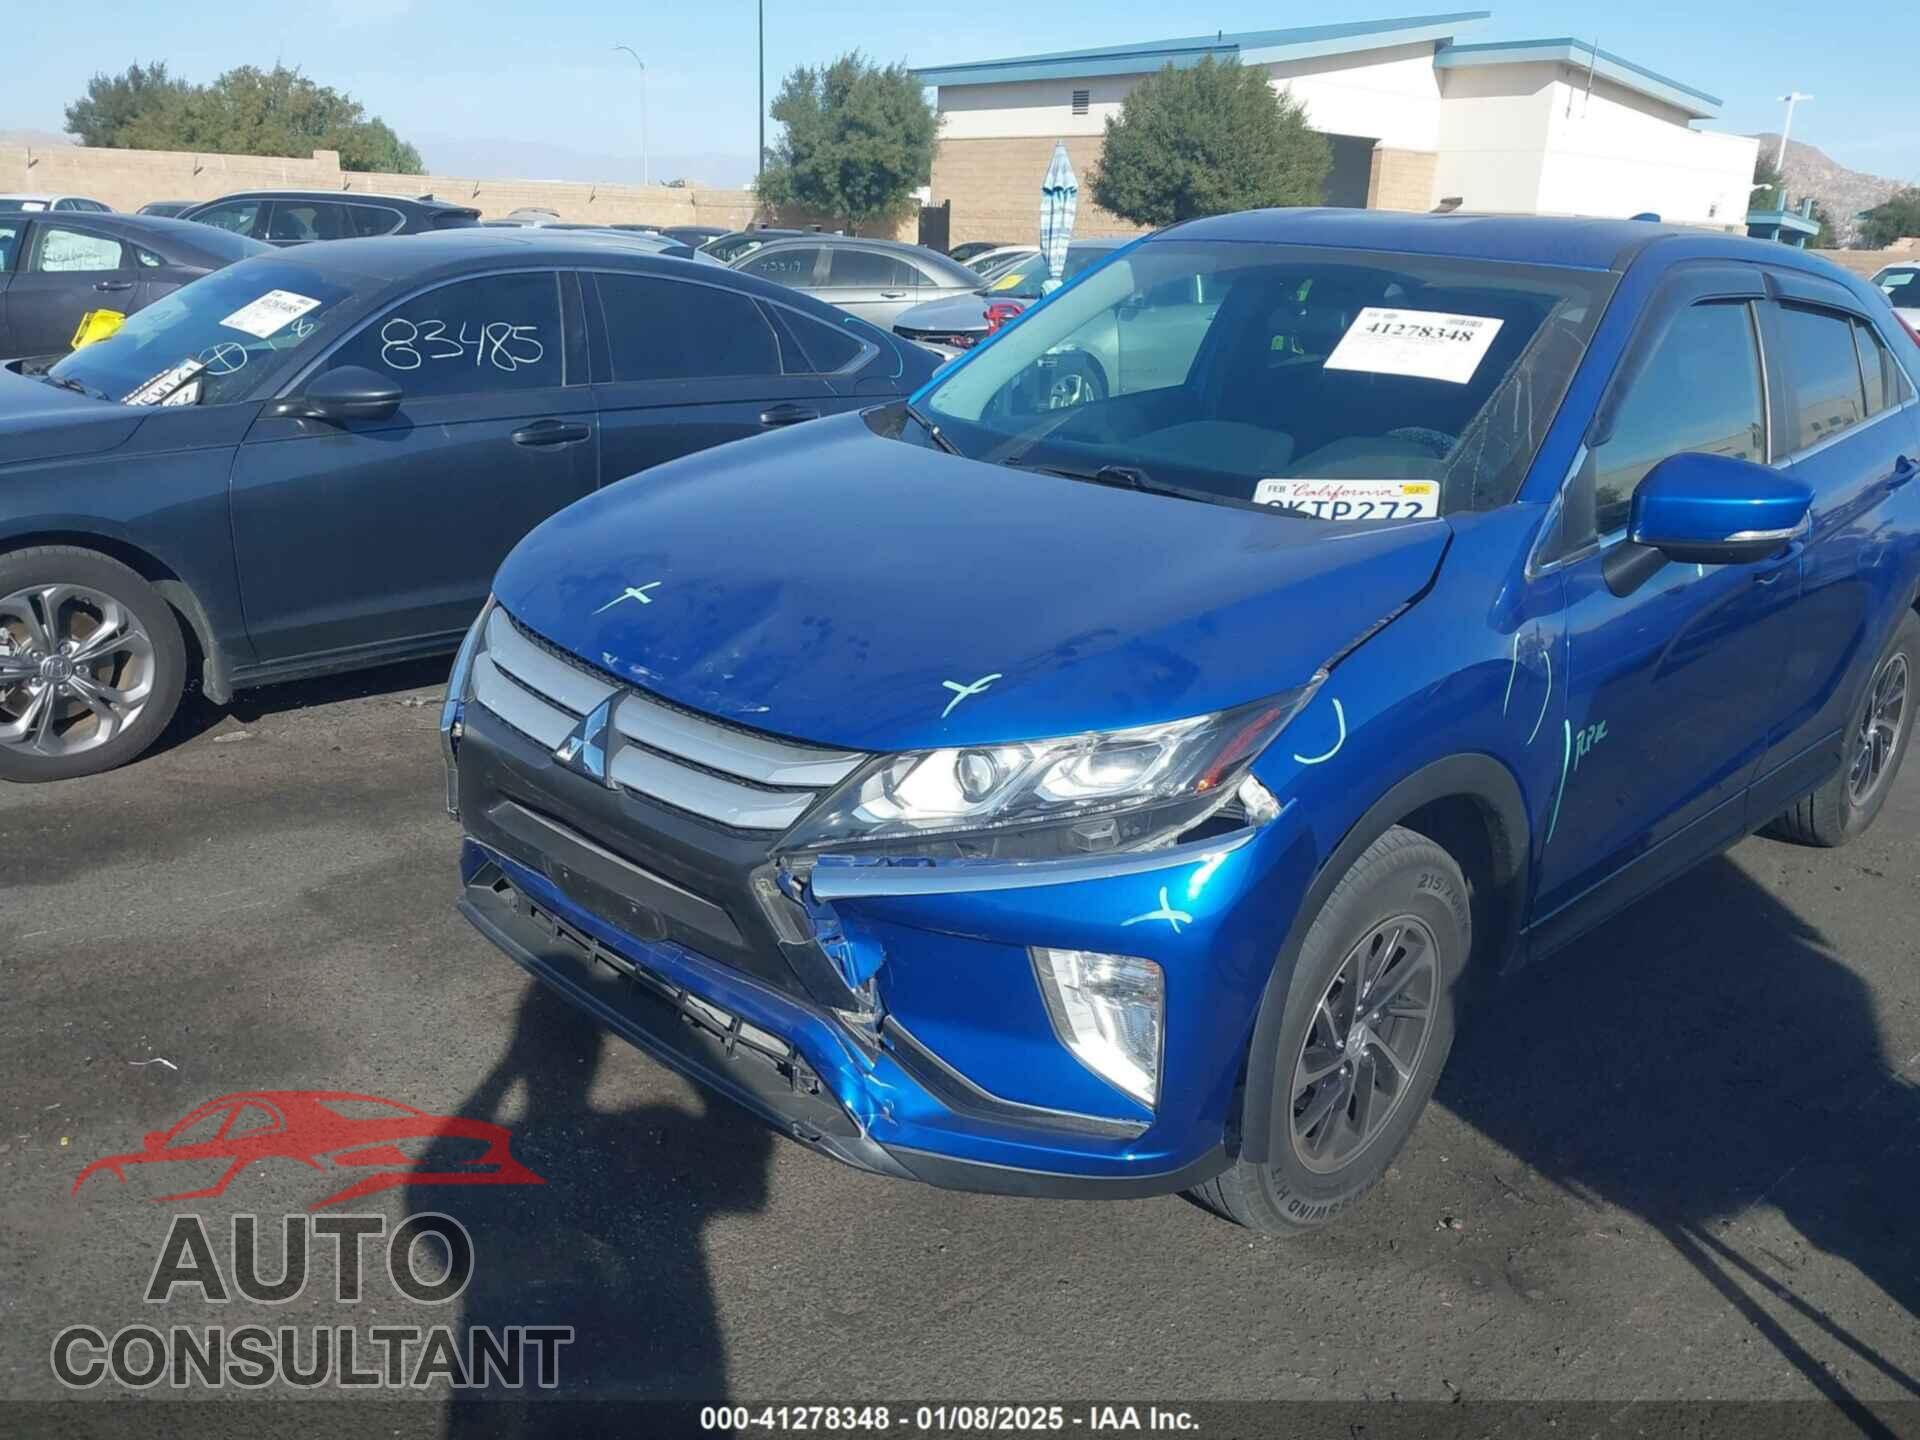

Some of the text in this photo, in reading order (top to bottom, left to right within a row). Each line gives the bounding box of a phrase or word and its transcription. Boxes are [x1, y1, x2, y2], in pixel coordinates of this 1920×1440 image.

[1365, 322, 1475, 342] 41278348
[381, 318, 543, 371] 83485
[1266, 484, 1287, 493] FEB
[1292, 483, 1403, 501] California
[1265, 499, 1424, 520] TP272
